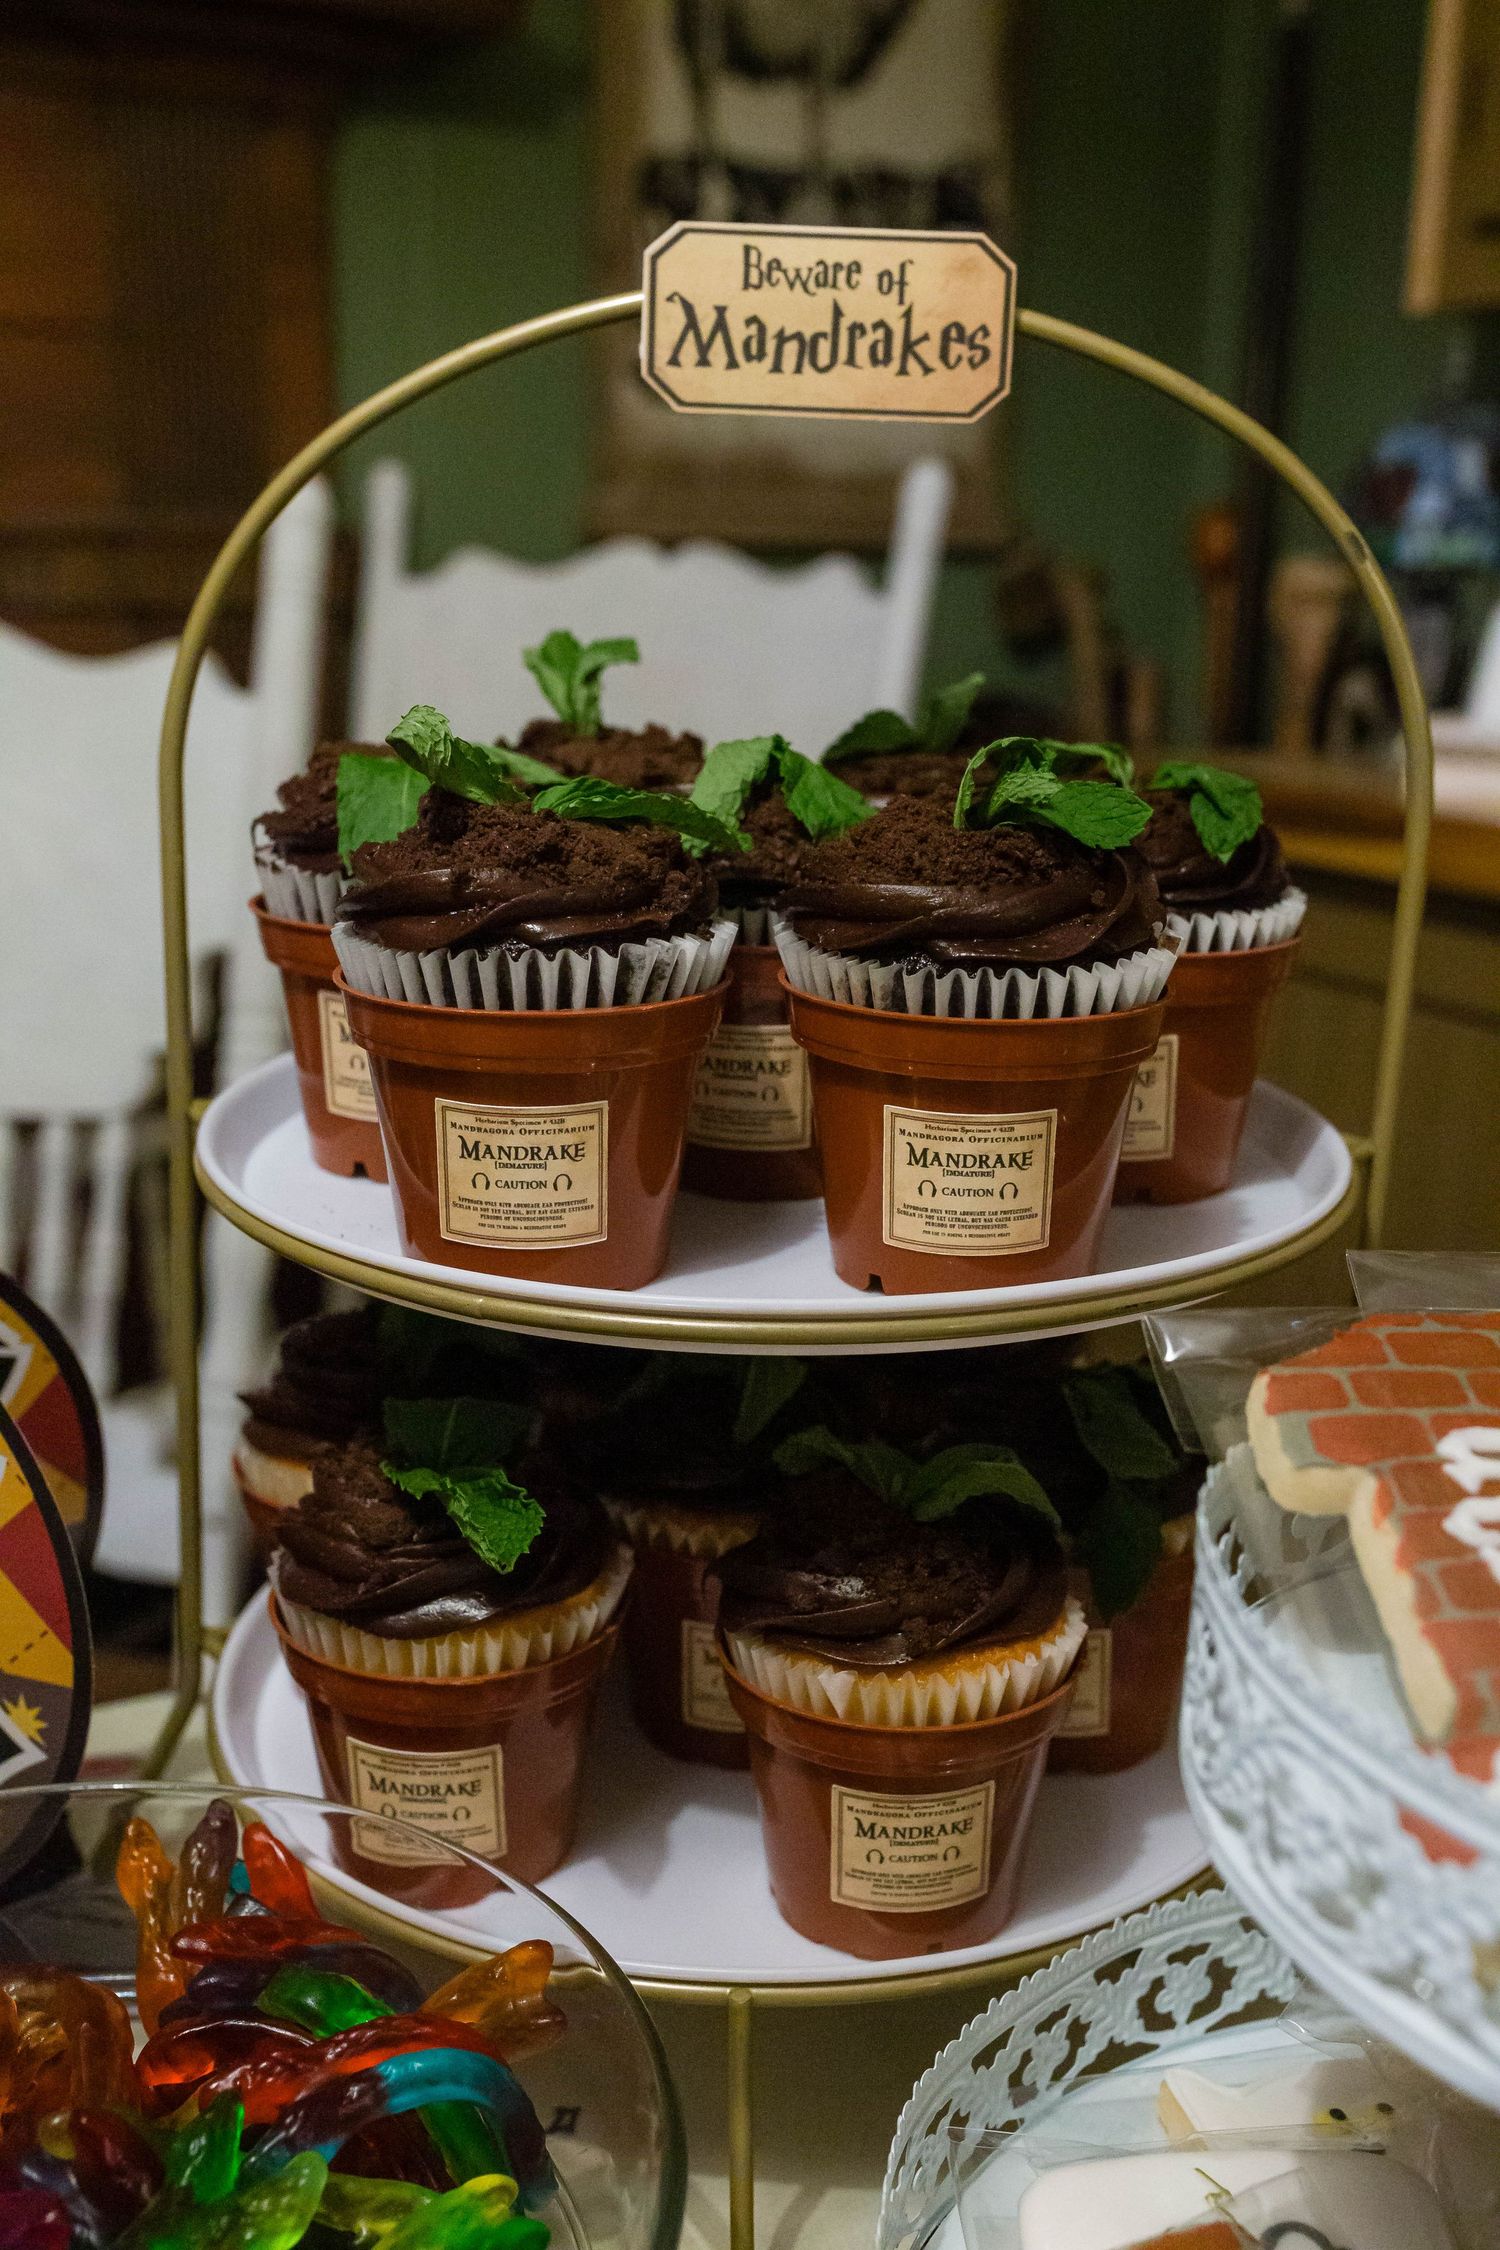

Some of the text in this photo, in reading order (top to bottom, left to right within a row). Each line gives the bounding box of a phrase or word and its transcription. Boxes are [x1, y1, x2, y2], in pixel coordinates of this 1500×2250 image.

[741, 244, 914, 306] Beware of
[665, 291, 991, 377] Mandrakes
[450, 1121, 515, 1136] MANDRAGORA
[899, 1128, 965, 1143] MANDRAGORA
[458, 1134, 586, 1163] MANDRAKE
[906, 1141, 1033, 1171] MANDRAKE
[495, 1179, 548, 1190] CAUTION
[941, 1187, 994, 1197] CAUTION
[367, 1771, 481, 1797] MANDRAKE
[854, 1816, 974, 1840] MANDRAKE
[889, 1853, 938, 1863] CAUTION
